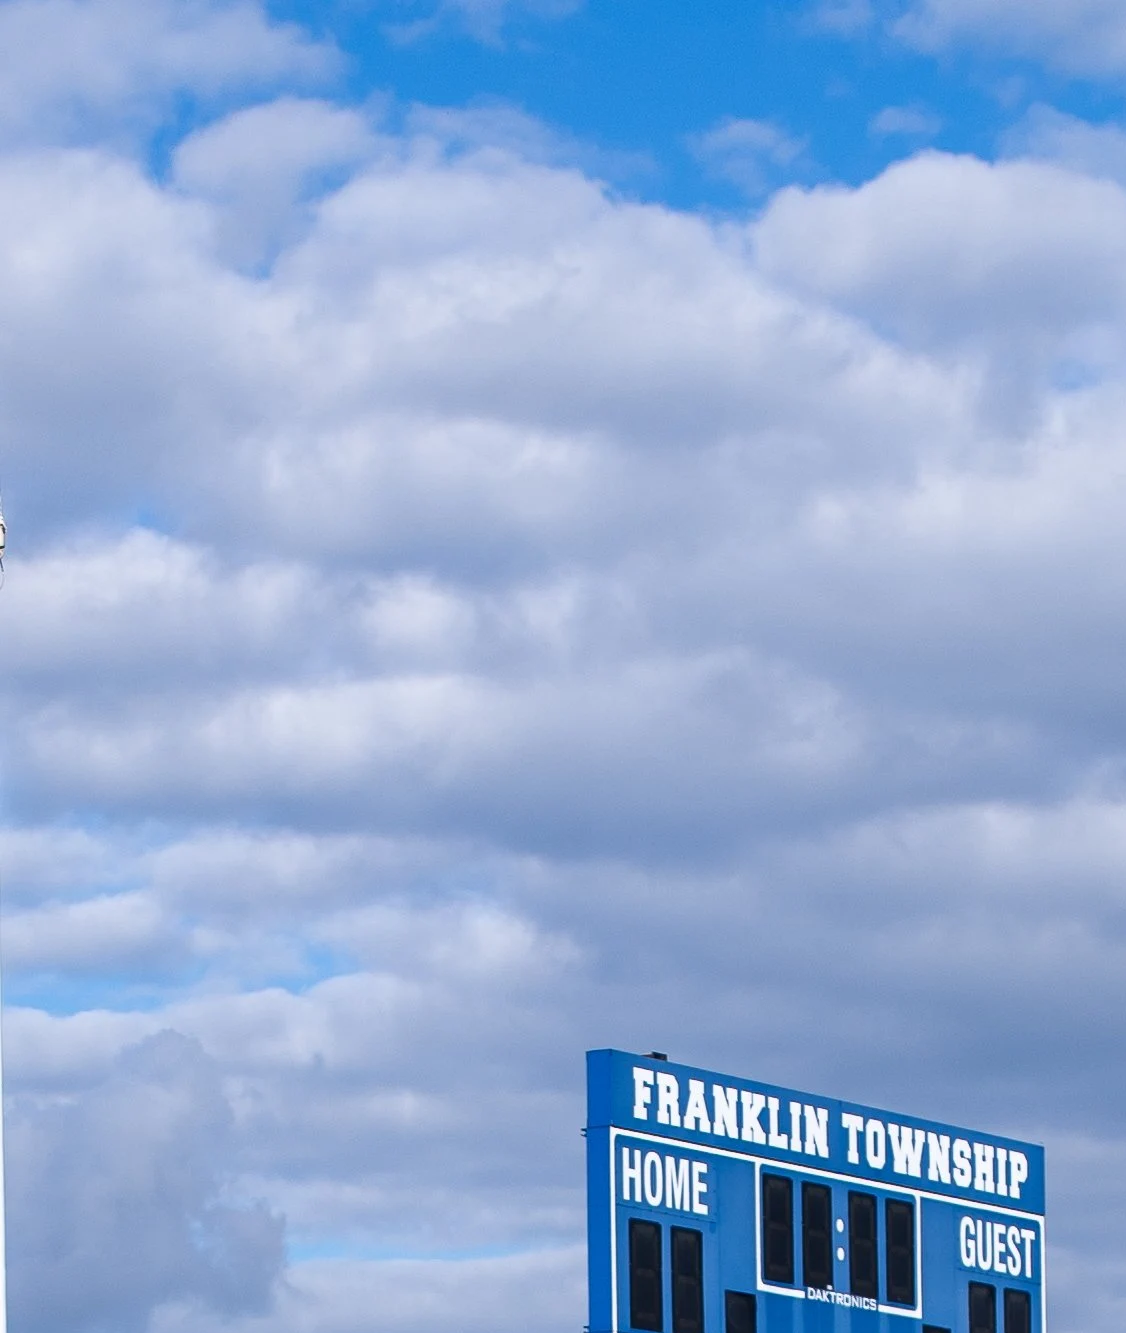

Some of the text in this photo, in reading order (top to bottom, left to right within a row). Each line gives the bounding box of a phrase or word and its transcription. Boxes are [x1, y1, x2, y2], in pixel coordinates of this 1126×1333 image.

[632, 1066, 1029, 1199] FRANKLIN TOWNSHIP
[621, 1146, 709, 1216] HOME
[959, 1215, 1036, 1279] GUEST
[807, 1286, 877, 1311] DAKTRONICS
